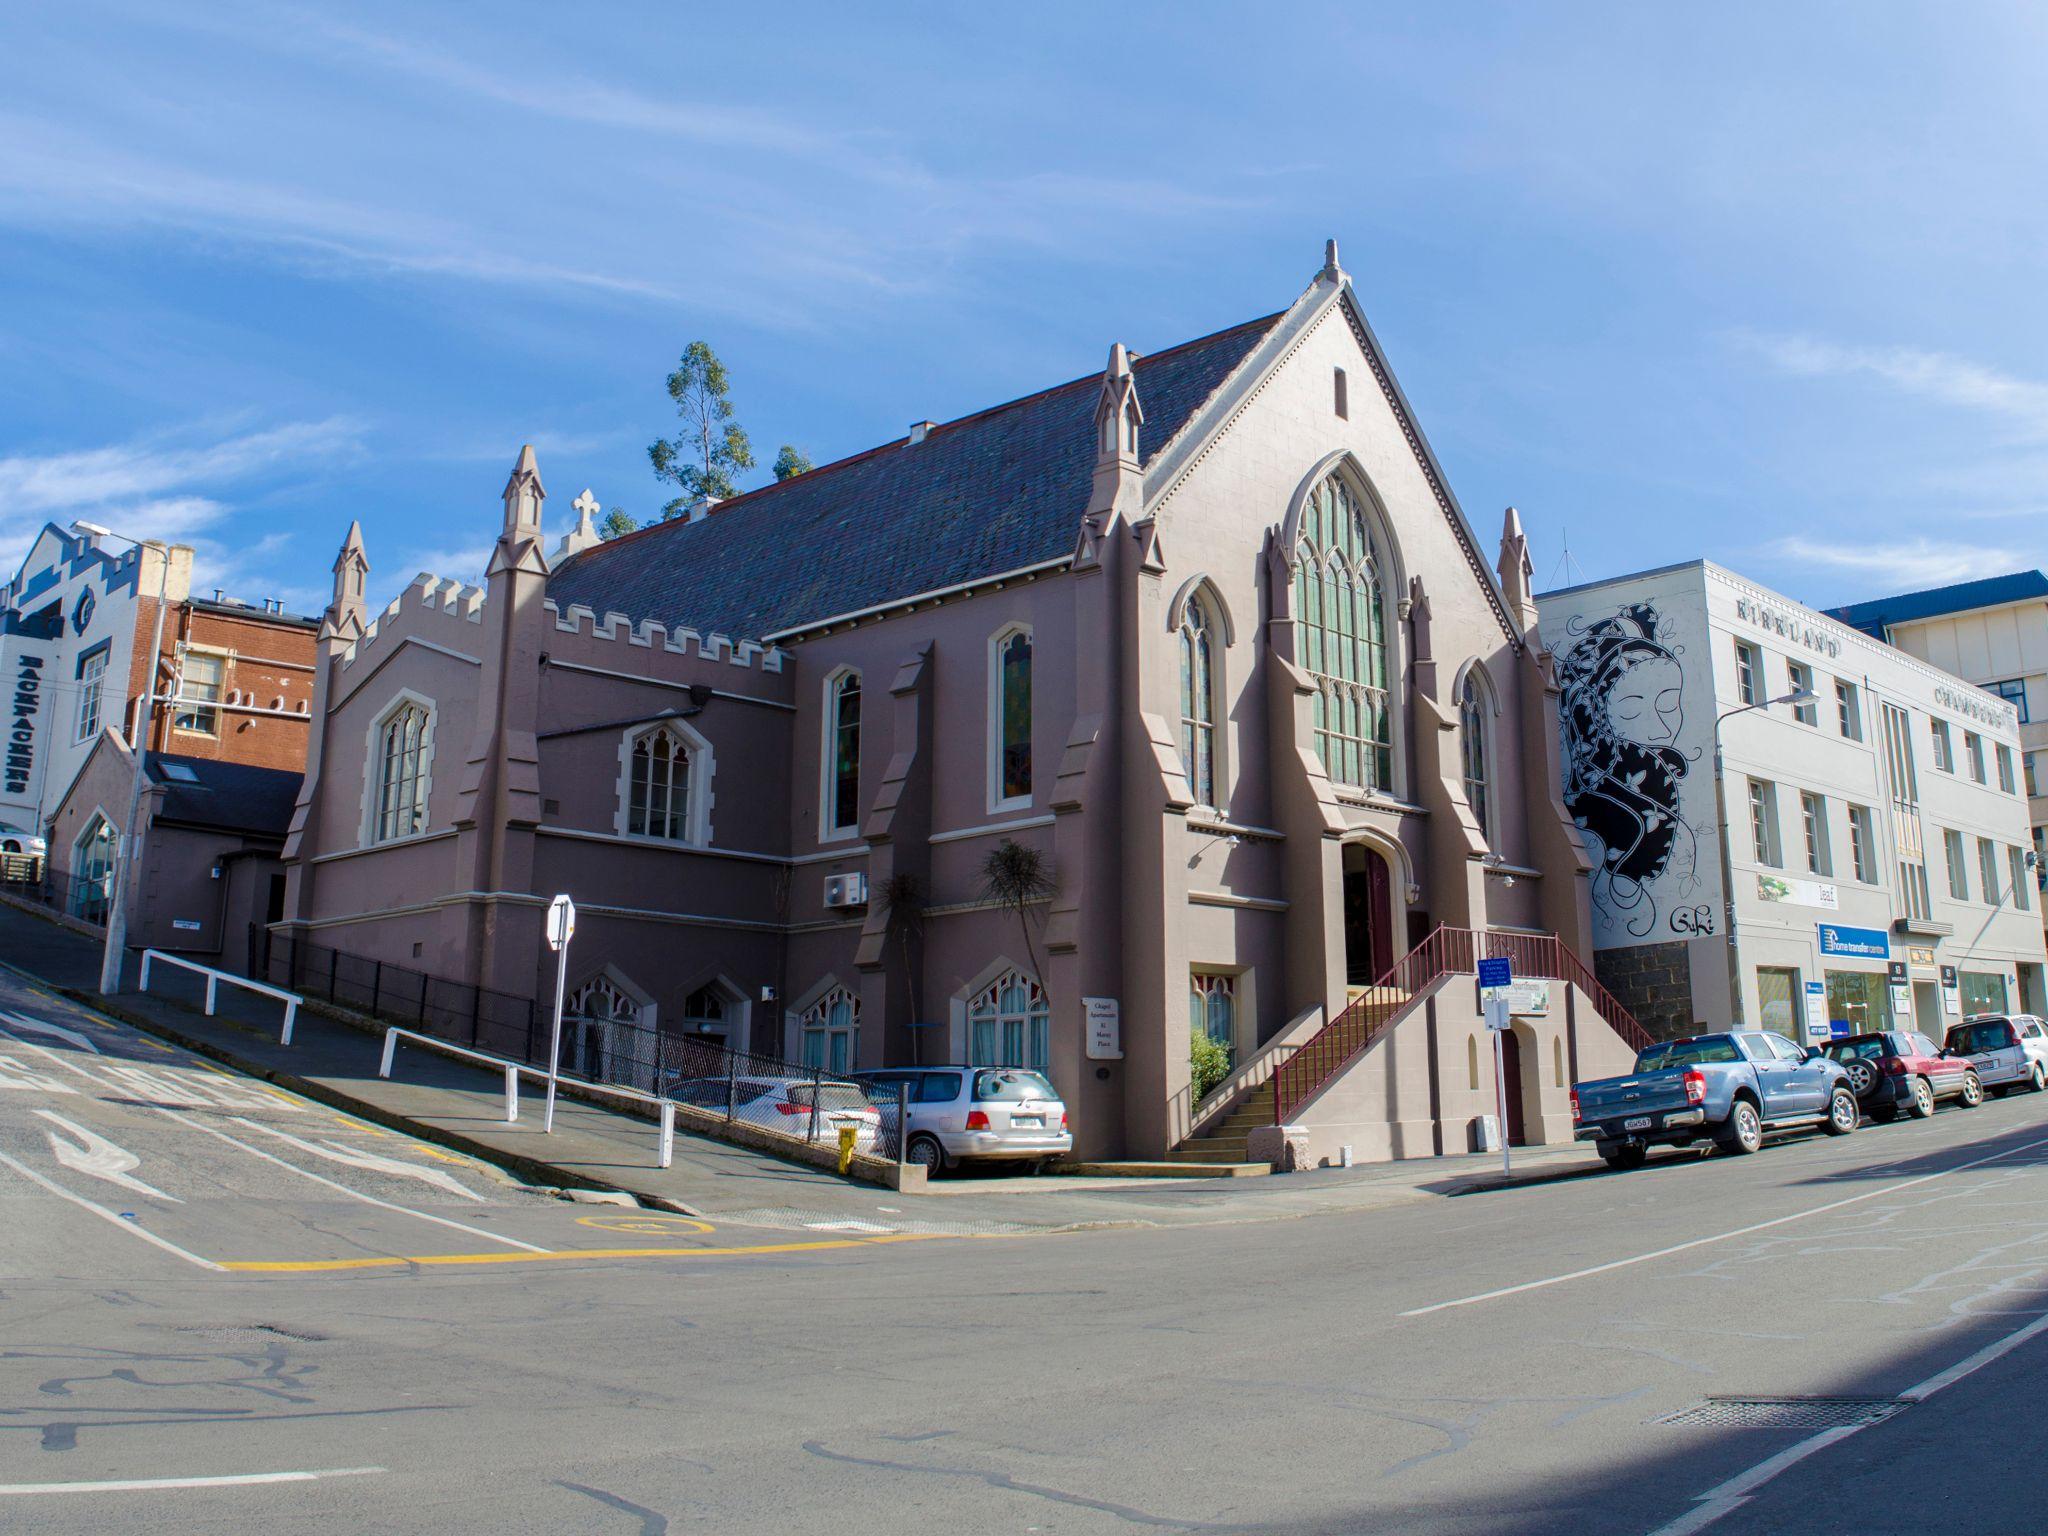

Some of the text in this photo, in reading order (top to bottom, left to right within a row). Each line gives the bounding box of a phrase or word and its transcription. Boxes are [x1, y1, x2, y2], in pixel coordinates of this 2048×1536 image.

[1736, 599, 1837, 659] KIRKLAND
[5, 655, 44, 794] BACKPACKERS
[1819, 885, 1834, 902] leaf
